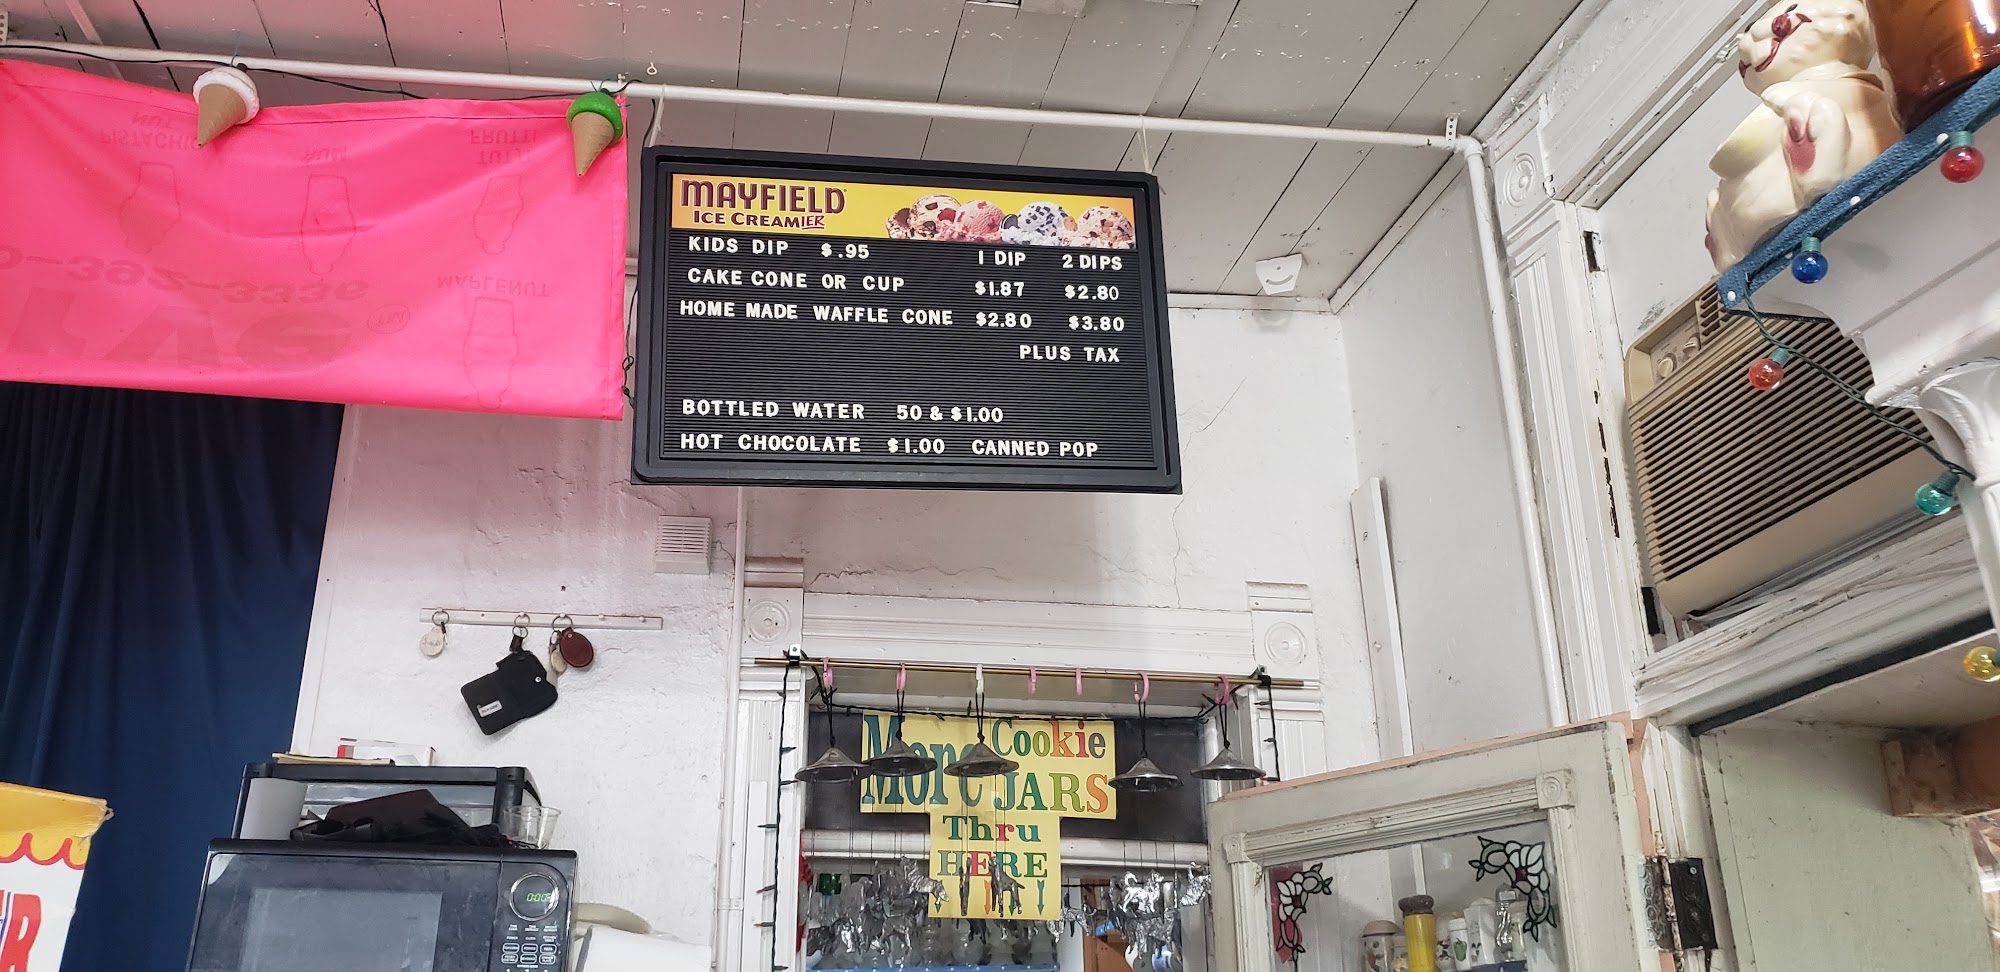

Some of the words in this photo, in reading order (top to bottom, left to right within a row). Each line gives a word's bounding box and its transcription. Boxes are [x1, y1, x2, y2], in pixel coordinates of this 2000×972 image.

[681, 179, 845, 214] MAYFIELD
[693, 210, 726, 225] ICE
[688, 236, 739, 253] KIDS
[752, 239, 789, 255] DIP
[821, 243, 870, 259] $.95
[994, 251, 1026, 266] DIP
[1062, 254, 1074, 269] 2
[1079, 255, 1122, 270] DIPS
[687, 268, 743, 285] CAKE
[751, 271, 807, 288] CONE
[821, 274, 847, 290] OR
[862, 275, 904, 292] CUP
[975, 281, 1025, 297] $1.87
[1064, 285, 1119, 300] $2.80
[680, 300, 735, 318] HOME
[745, 303, 798, 319] MADE
[813, 305, 889, 323] WAFFLE
[902, 308, 953, 325] CONE
[975, 311, 1032, 328] $2.80
[1068, 315, 1125, 332] $3.80
[1019, 345, 1071, 361] PLUS
[1084, 346, 1120, 363] TAX
[682, 399, 779, 417] BOTTLED
[792, 402, 865, 419] WATER
[896, 404, 923, 421] 50
[930, 405, 943, 421] &
[951, 406, 1004, 423] $1.00
[680, 433, 723, 450] HOT
[738, 434, 861, 453] CHOCOLATE
[888, 437, 945, 454] $1.00
[972, 439, 1050, 456] CANNED
[1059, 442, 1098, 457] POP
[992, 716, 1106, 759] Cookie
[862, 714, 983, 807] More
[993, 771, 1109, 814] JARS
[942, 815, 1042, 842] Thru
[936, 850, 1048, 878] HERE
